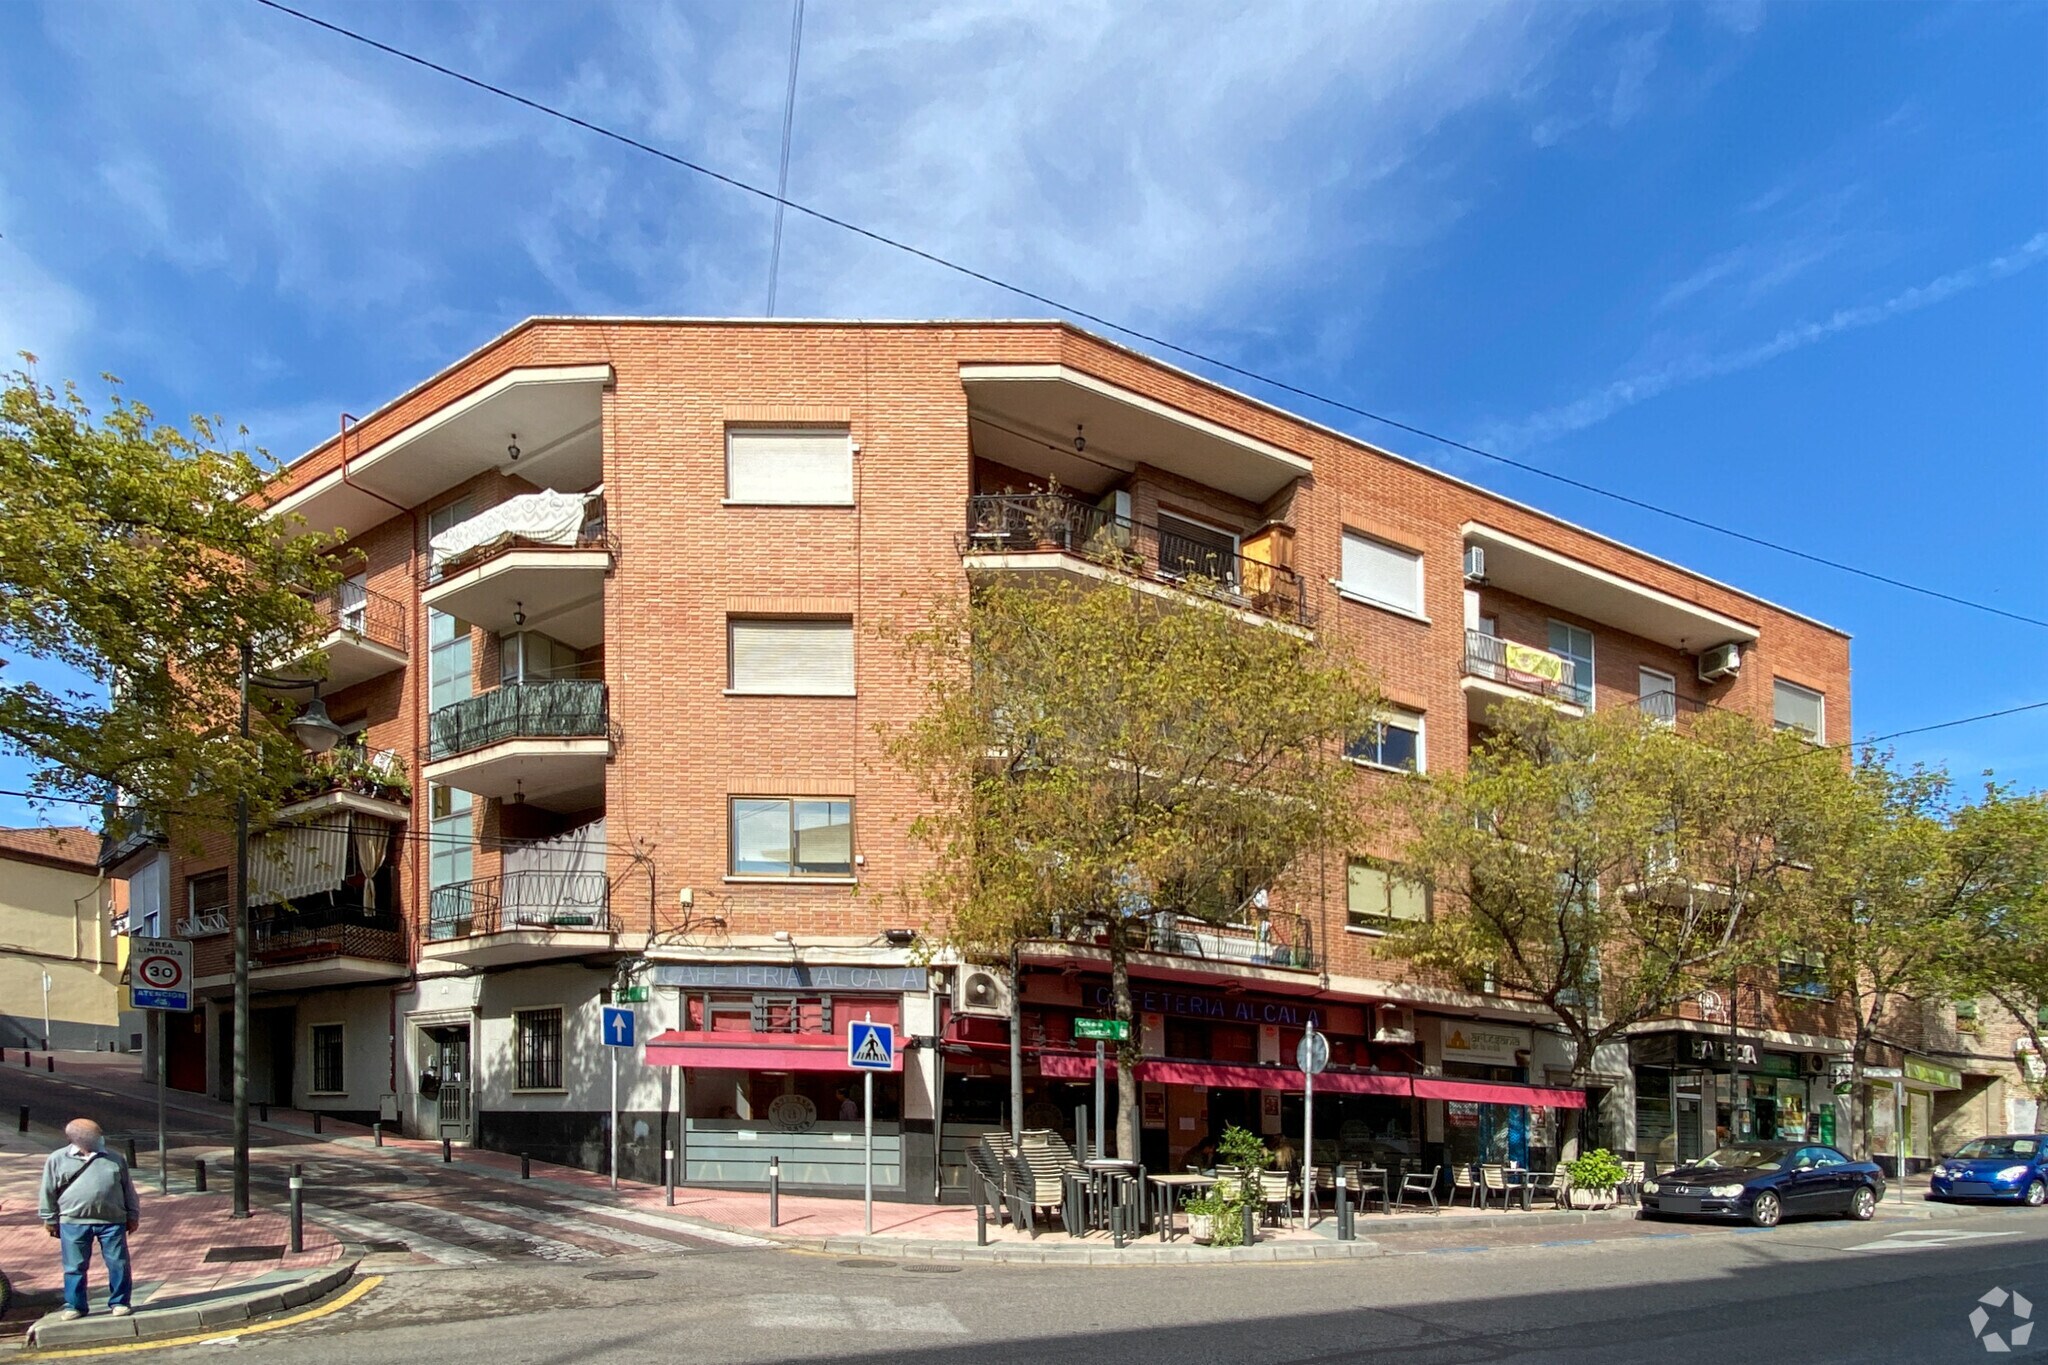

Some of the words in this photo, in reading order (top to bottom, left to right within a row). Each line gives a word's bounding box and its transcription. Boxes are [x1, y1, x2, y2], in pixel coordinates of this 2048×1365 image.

[138, 947, 183, 956] LIMITADA
[149, 966, 173, 978] 30
[661, 966, 801, 988] CAFETERIA
[1096, 986, 1225, 1018] CFETERIA
